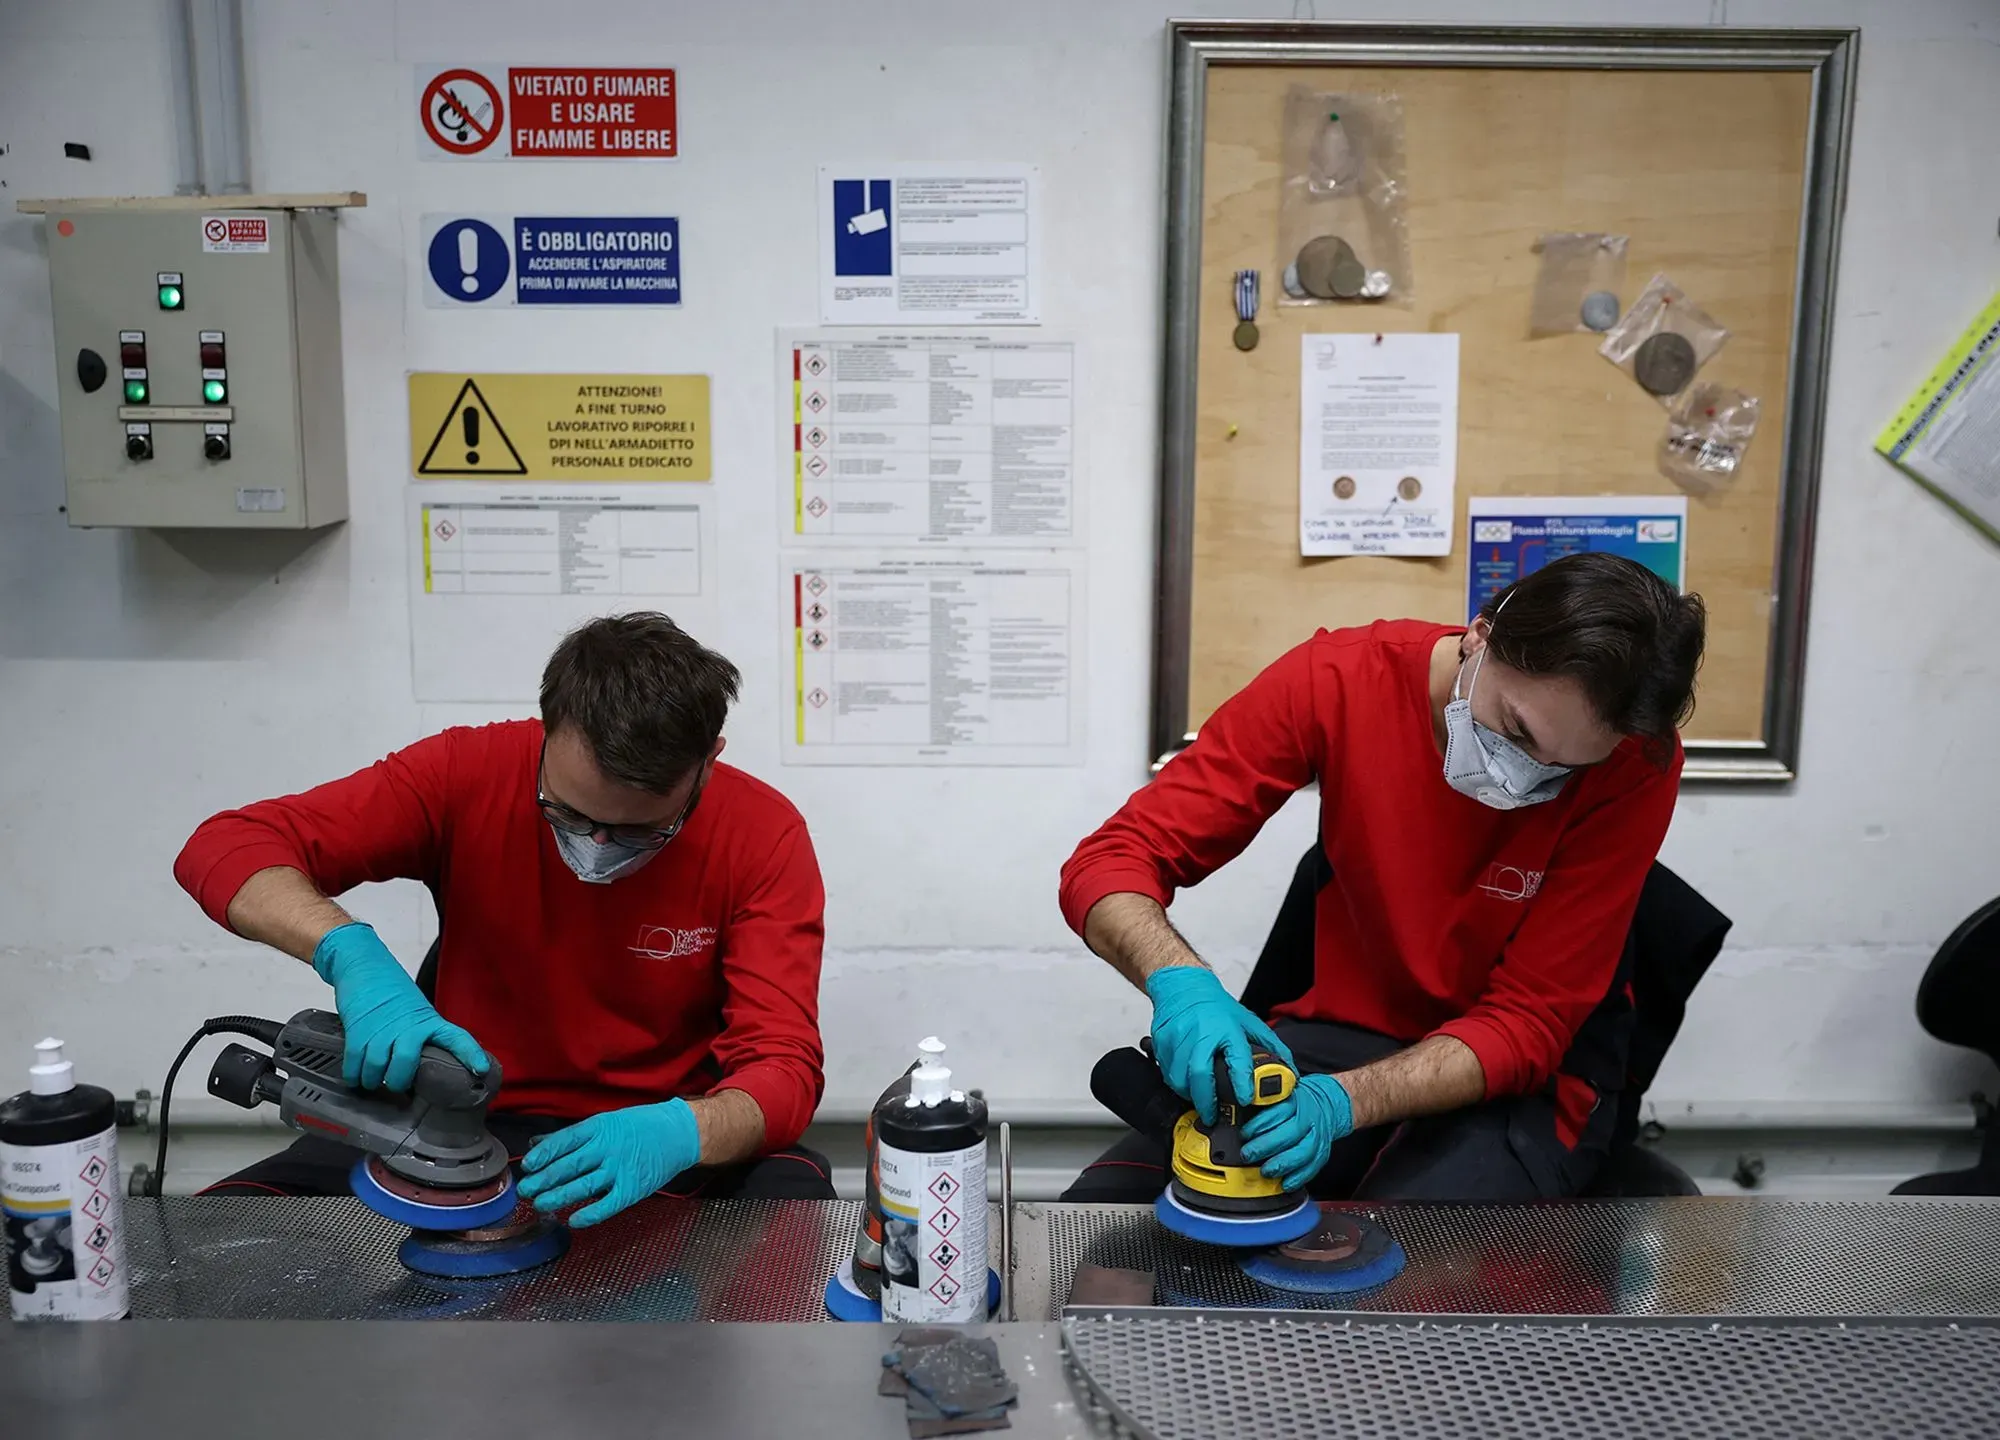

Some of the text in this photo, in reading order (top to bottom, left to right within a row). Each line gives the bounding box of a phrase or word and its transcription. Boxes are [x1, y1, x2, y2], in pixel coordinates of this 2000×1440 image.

[514, 76, 671, 97] VIETATO FUMARE
[551, 102, 636, 123] E USARE
[516, 129, 672, 150] FIAMME LIBERE
[521, 226, 673, 252] È OBBLIGATORIO
[528, 257, 667, 271] ACCENDERE L'ASPIRATORE
[519, 276, 678, 290] PRIMA DI AVVIARE LA MACCHINA
[575, 403, 667, 415] A FINE TURNO
[547, 420, 696, 432] LAVORATIVO RIPORRE I
[549, 437, 695, 450] DPI NELL'ARMADIETTO
[551, 455, 693, 468] PERSONALE DEDICATO
